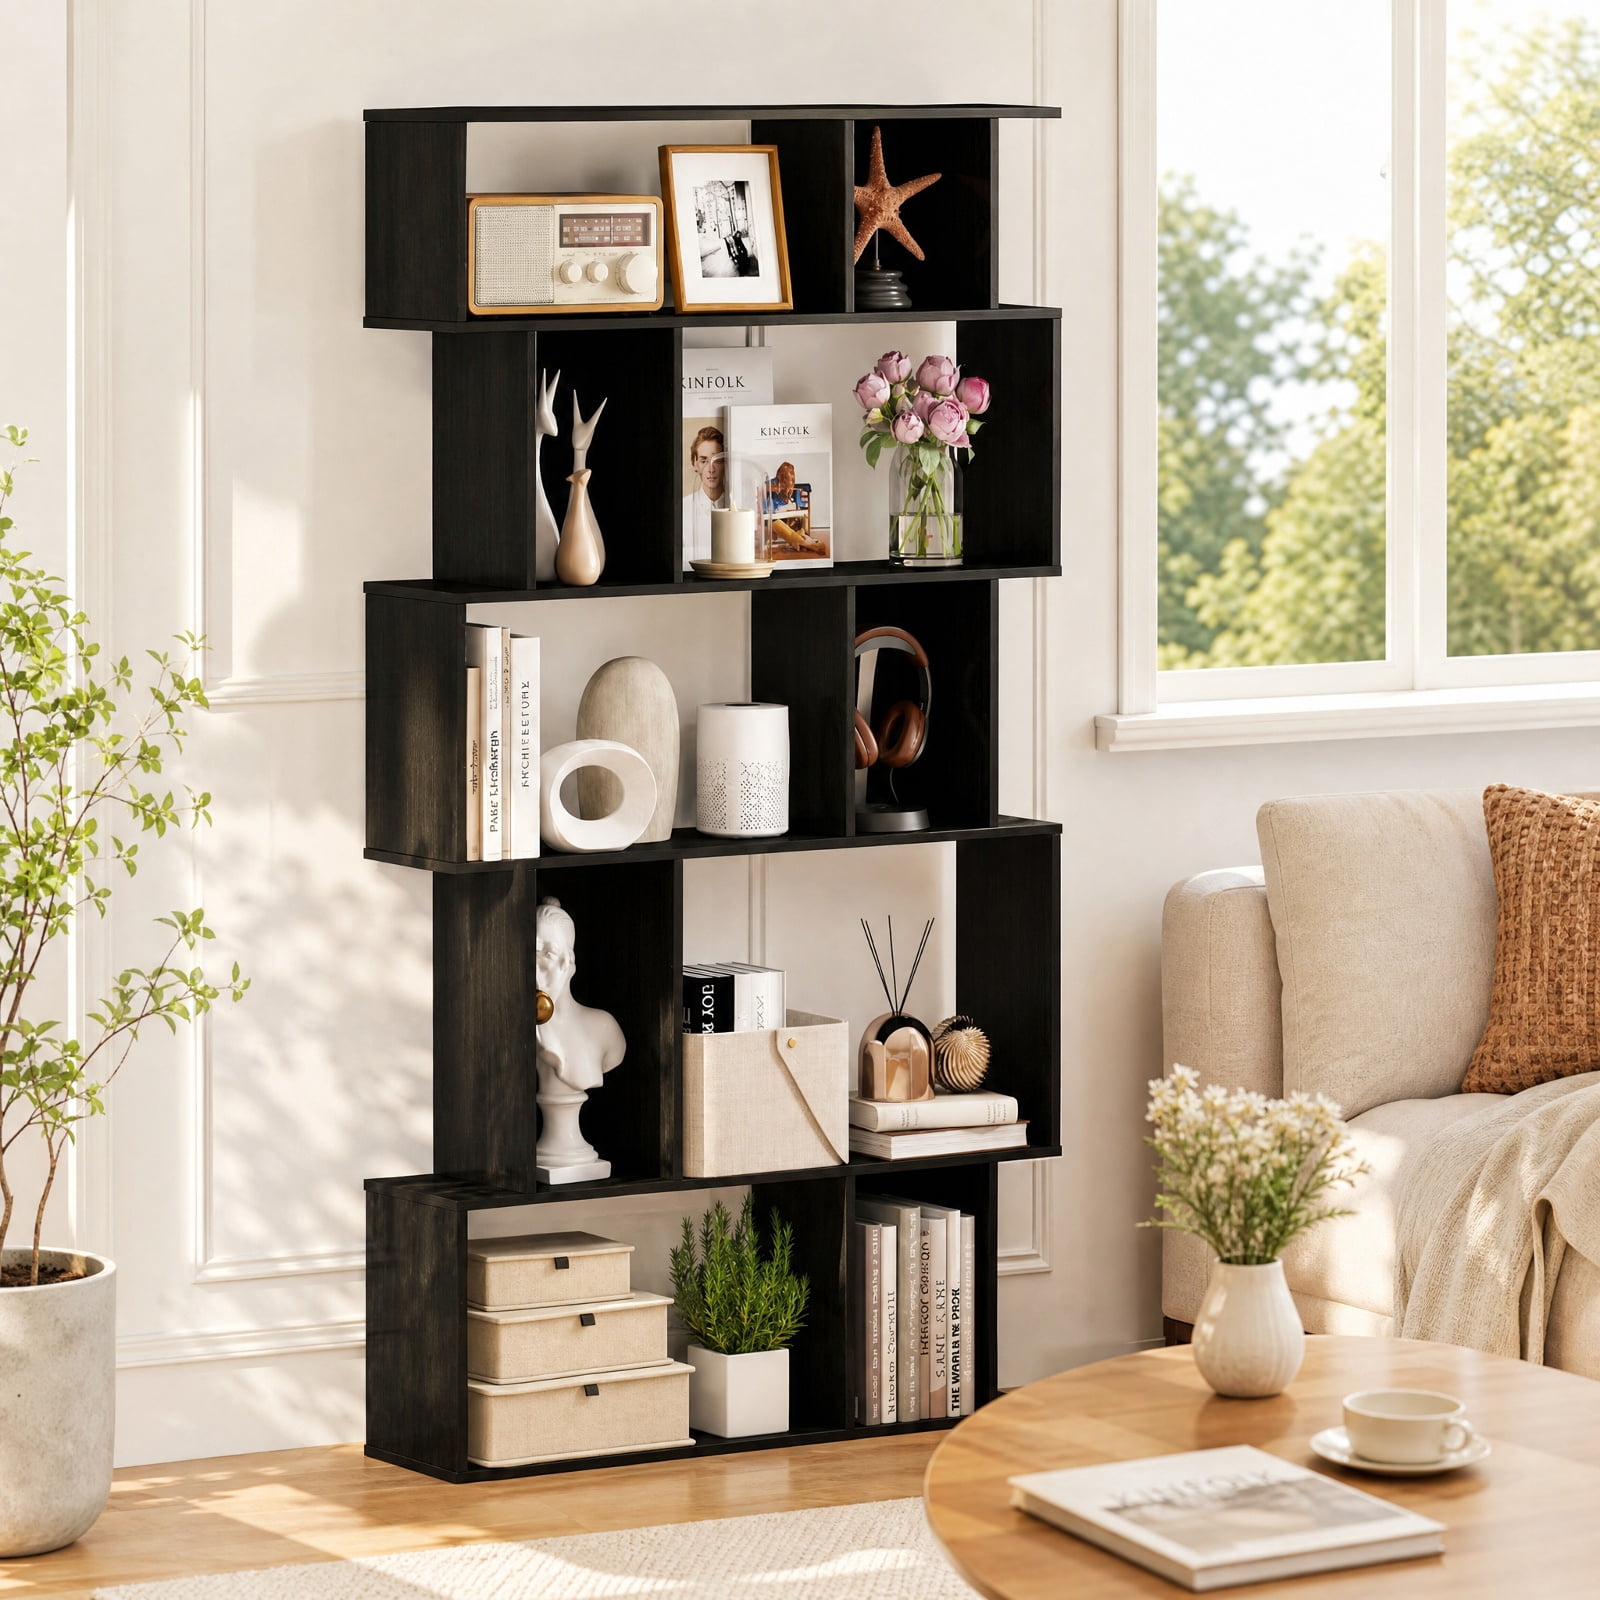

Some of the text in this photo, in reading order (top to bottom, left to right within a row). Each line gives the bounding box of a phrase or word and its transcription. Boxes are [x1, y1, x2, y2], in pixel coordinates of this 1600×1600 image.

[760, 426, 810, 437] KINFOLK
[701, 984, 715, 1019] JOY
[951, 1387, 960, 1412] THE
